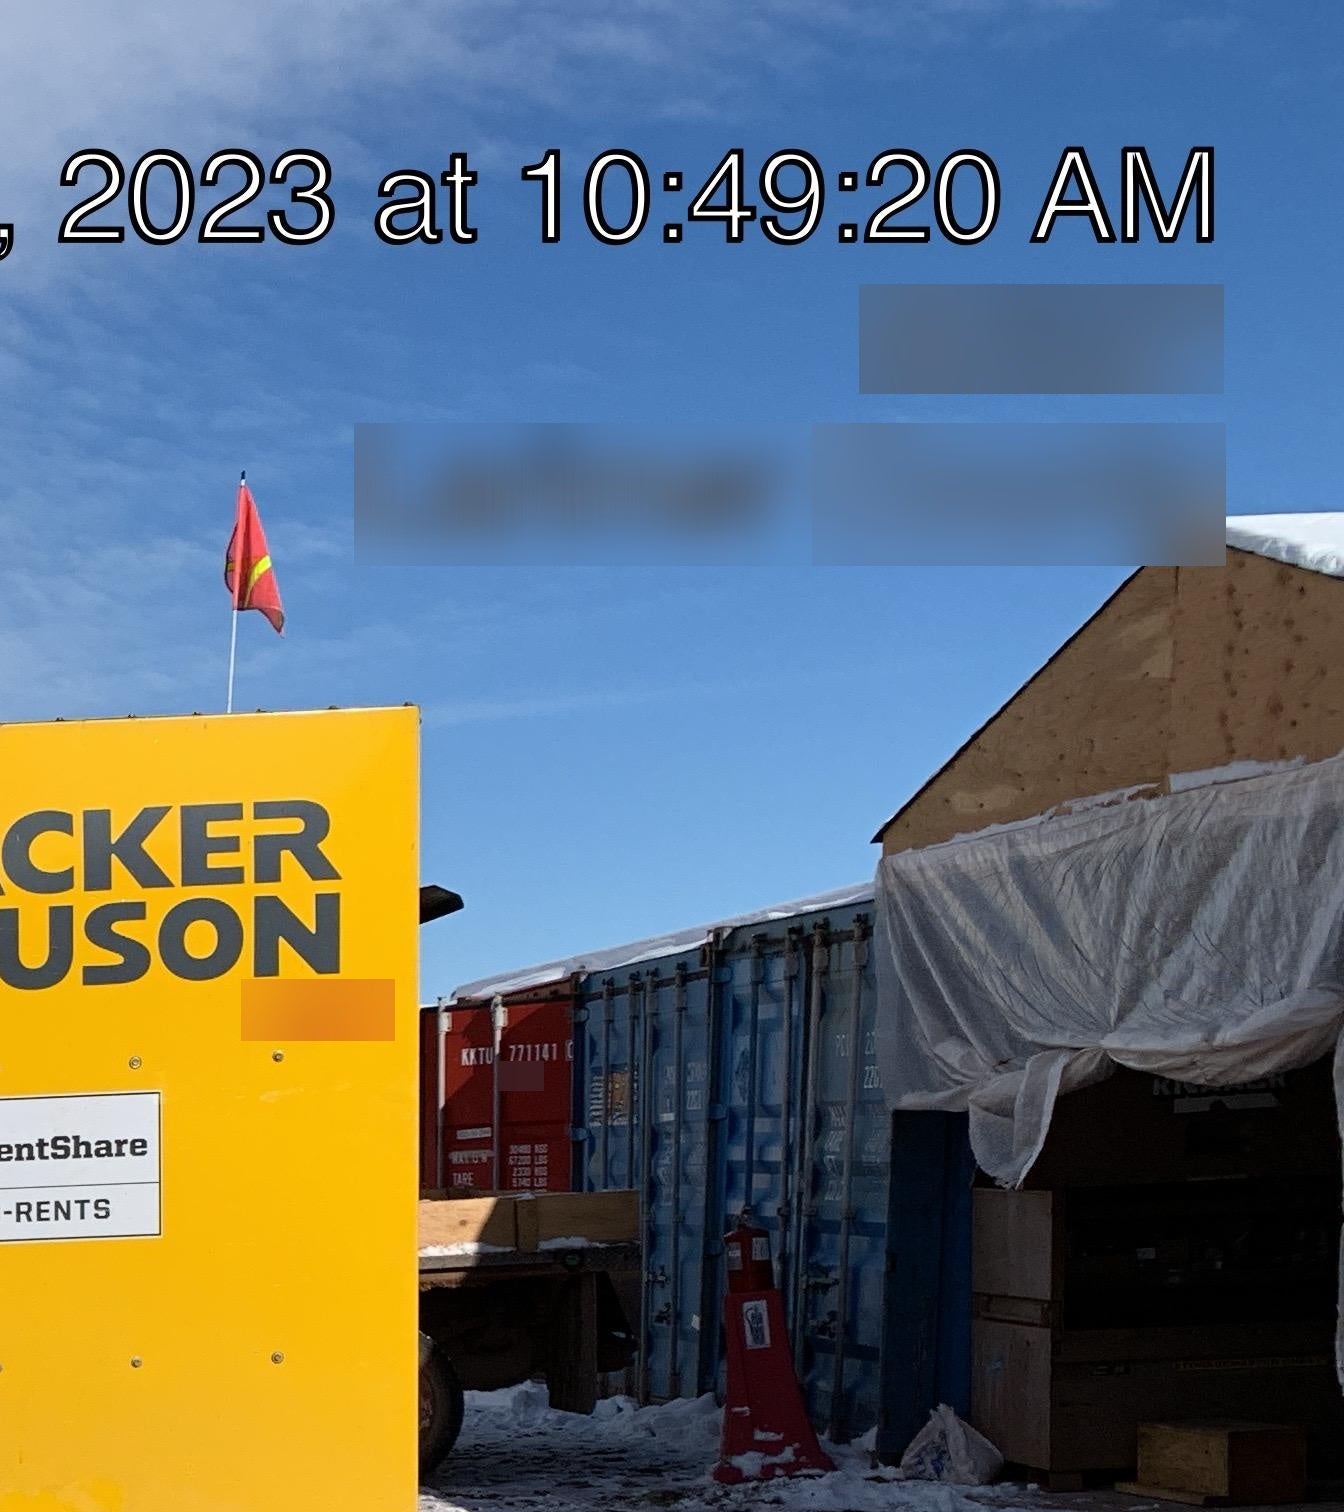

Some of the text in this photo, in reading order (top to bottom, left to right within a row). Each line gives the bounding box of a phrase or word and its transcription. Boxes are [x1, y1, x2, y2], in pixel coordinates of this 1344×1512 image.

[460, 1047, 493, 1066] KKTU
[508, 1043, 558, 1062] 771141
[452, 1172, 474, 1186] TARE
